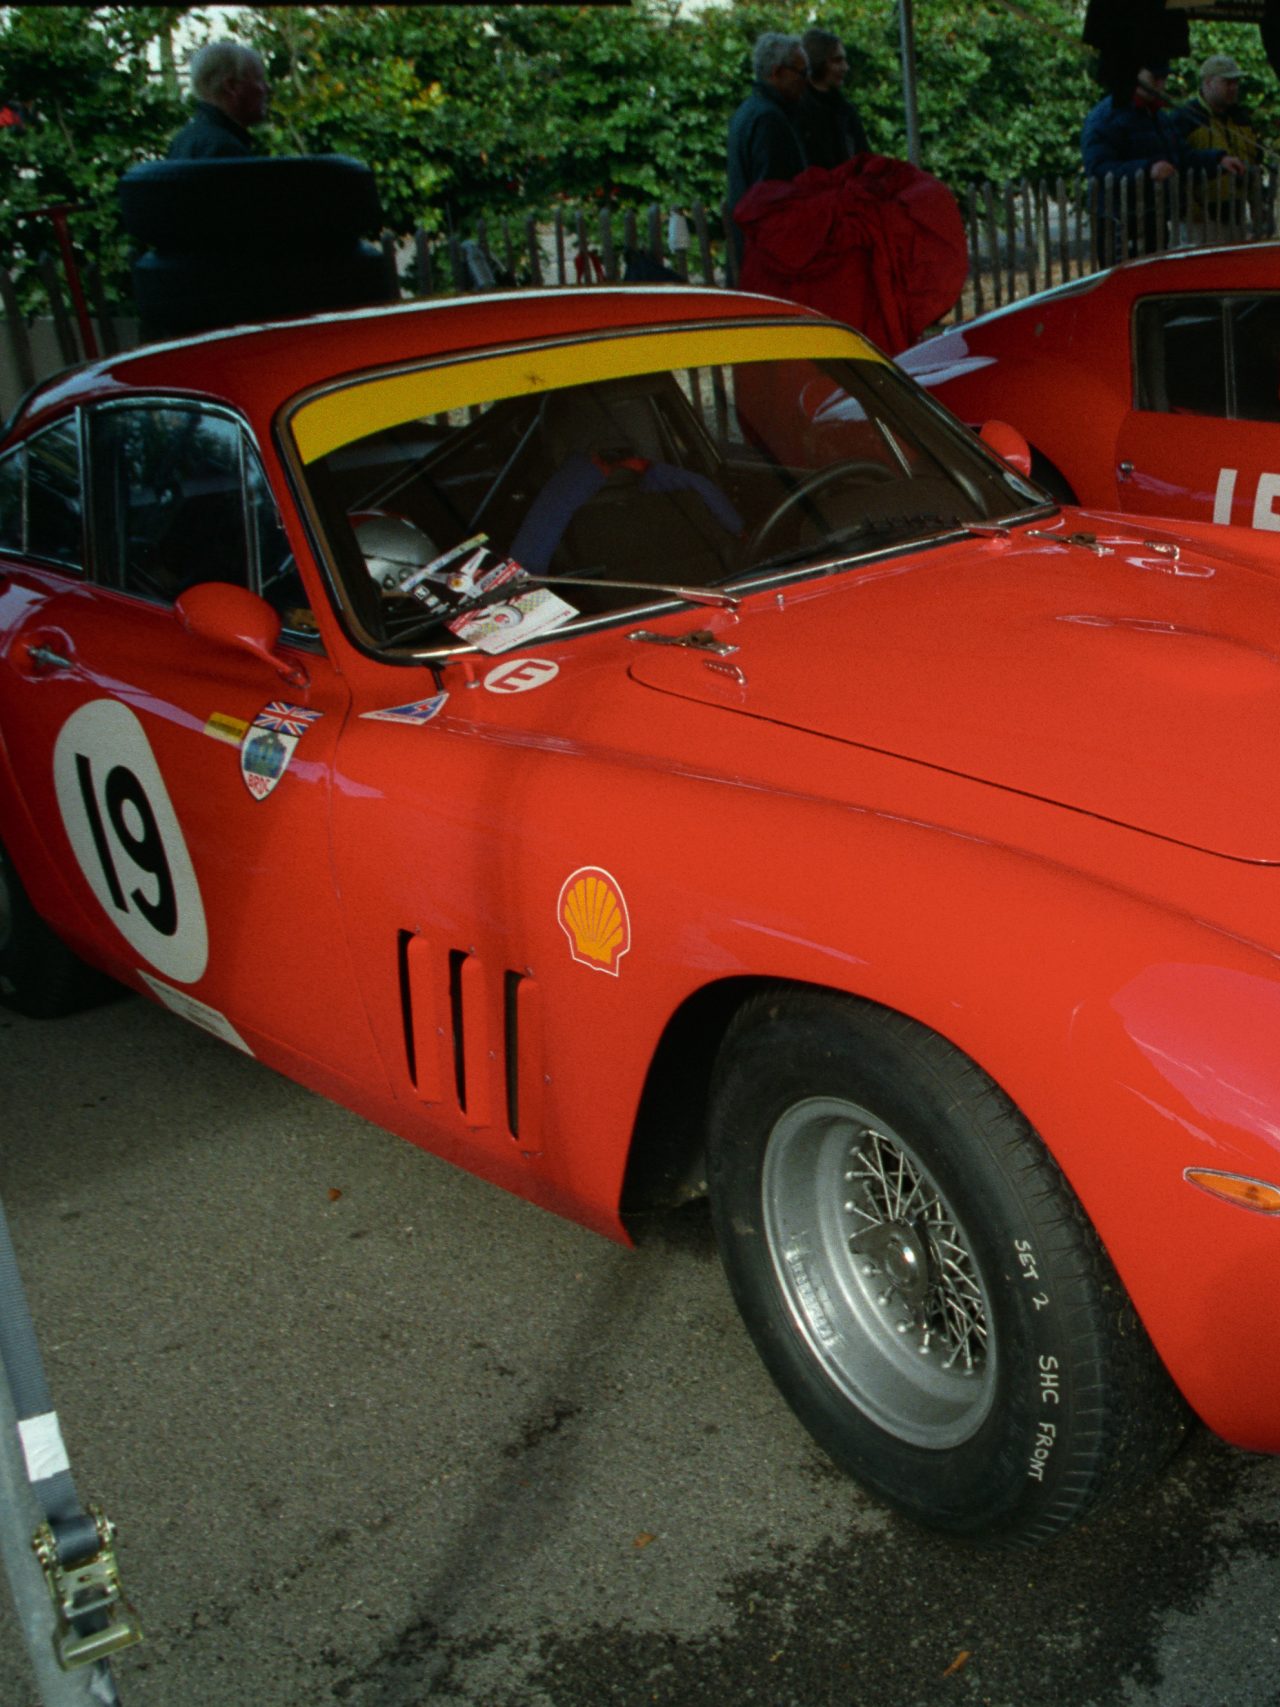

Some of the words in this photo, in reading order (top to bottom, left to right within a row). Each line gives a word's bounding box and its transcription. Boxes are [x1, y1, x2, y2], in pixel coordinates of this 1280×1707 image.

[489, 660, 554, 691] E
[75, 753, 178, 937] 19
[1014, 1240, 1039, 1280] SET
[1032, 1292, 1049, 1311] 2
[1038, 1355, 1059, 1404] SHC
[1027, 1422, 1057, 1482] FRONT
